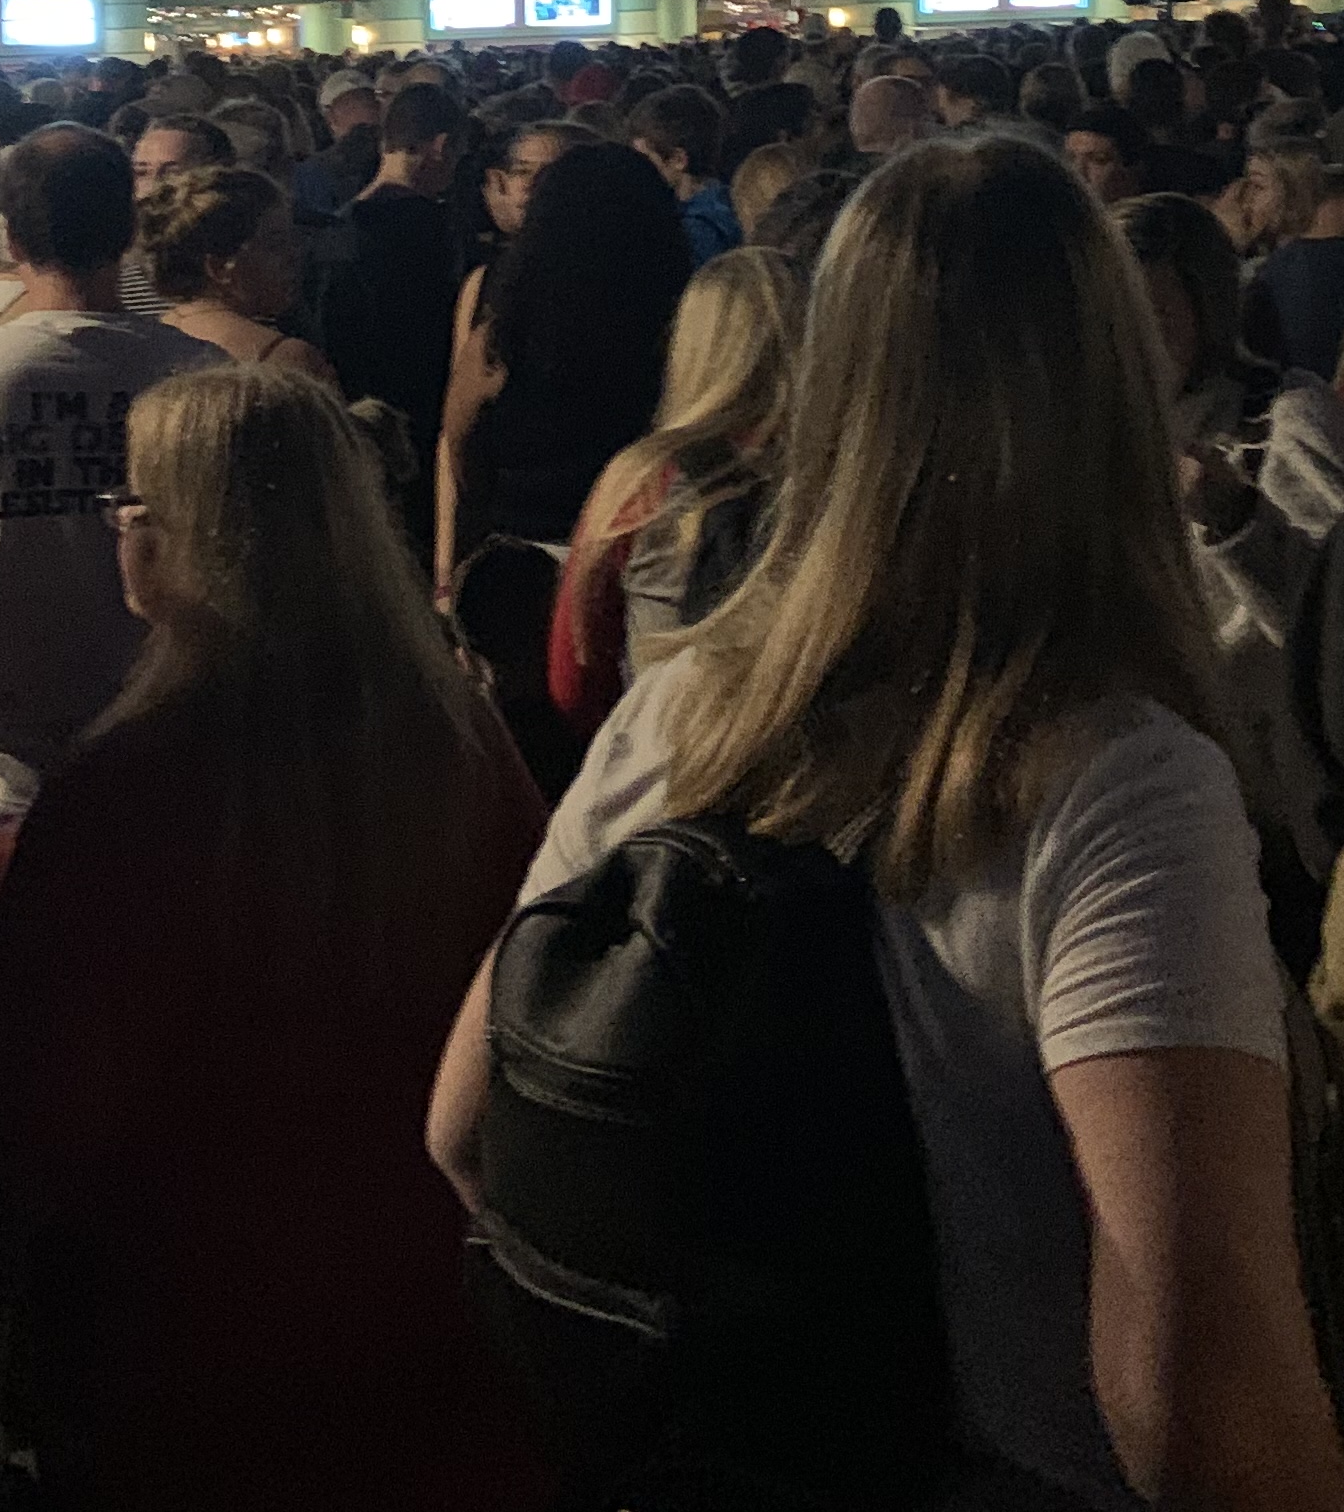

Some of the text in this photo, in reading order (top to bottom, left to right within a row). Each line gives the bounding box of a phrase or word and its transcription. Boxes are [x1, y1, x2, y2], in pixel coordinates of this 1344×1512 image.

[30, 391, 88, 422] I'M
[70, 420, 128, 455] DE
[72, 456, 128, 486] TH
